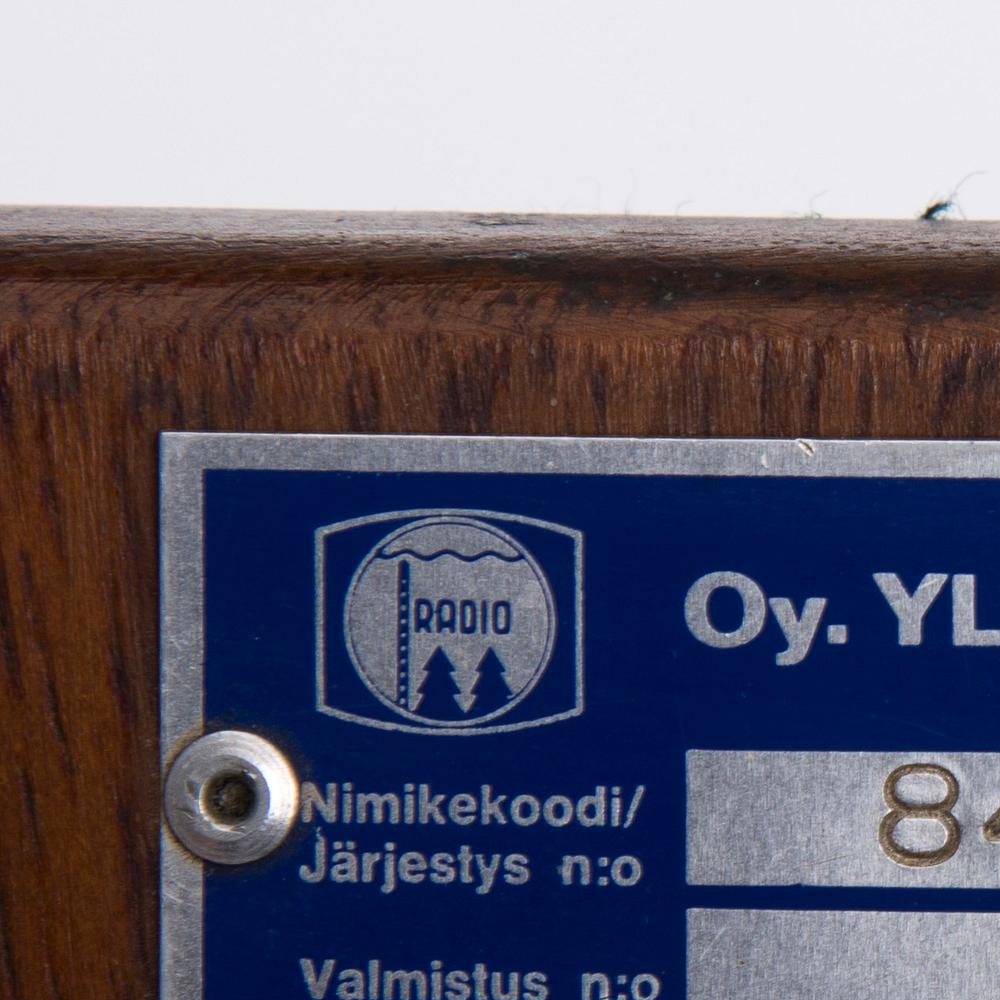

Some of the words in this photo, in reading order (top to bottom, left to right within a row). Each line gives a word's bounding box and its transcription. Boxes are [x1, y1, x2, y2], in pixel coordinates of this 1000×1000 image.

[413, 598, 512, 636] RADIO
[684, 571, 847, 666] Oy.
[300, 782, 646, 828] Nimikekoodi/
[299, 832, 531, 895] Järjestys
[561, 854, 643, 886] n:o
